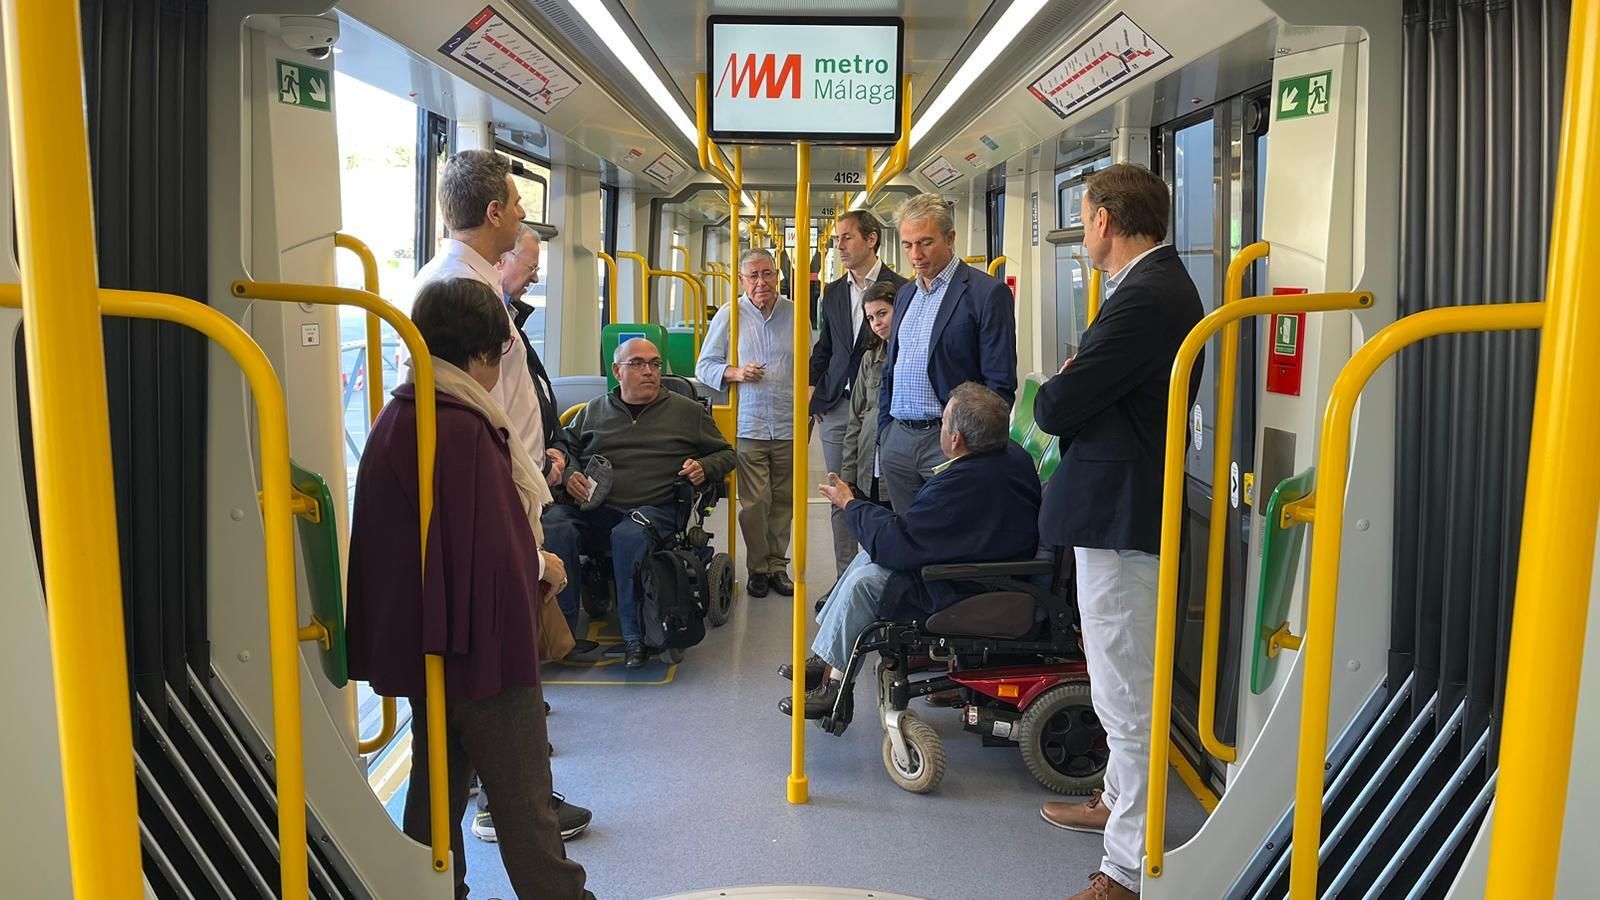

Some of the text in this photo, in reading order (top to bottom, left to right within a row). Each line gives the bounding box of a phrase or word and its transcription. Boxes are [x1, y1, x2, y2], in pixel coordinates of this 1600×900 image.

[814, 54, 889, 75] metro
[814, 79, 895, 105] Málaga
[834, 171, 860, 184] 4162
[821, 207, 837, 216] 416
